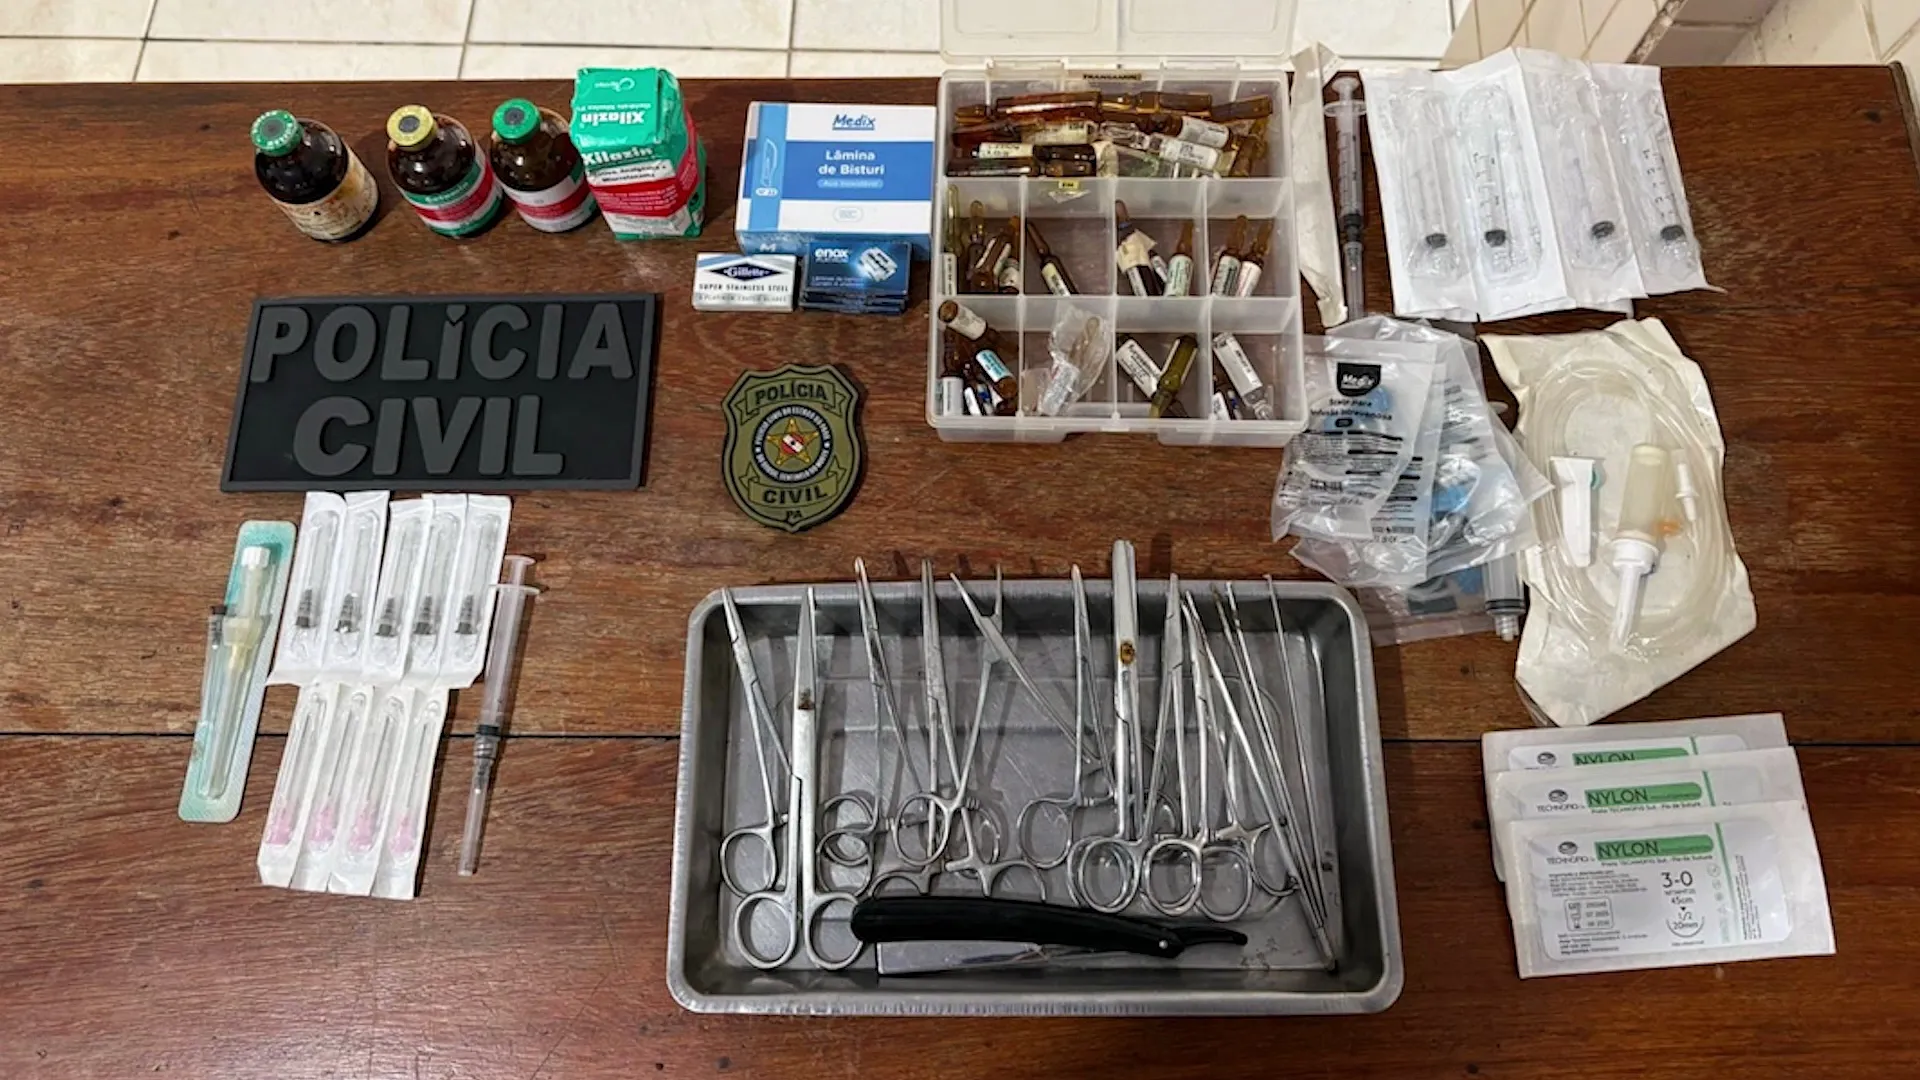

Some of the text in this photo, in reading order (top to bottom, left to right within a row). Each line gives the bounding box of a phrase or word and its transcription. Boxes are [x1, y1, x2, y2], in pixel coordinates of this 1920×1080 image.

[581, 110, 645, 126] Xilazin
[832, 114, 876, 130] Medix
[581, 146, 653, 167] Xilazin
[825, 149, 876, 161] Lâmina
[818, 163, 886, 176] de Bisturi
[815, 248, 849, 258] enox
[726, 266, 764, 278] Gillette
[699, 283, 788, 292] SUPER STAINLESS STEEL
[755, 380, 828, 404] POLÍCIA
[293, 395, 564, 476] CIVIL
[763, 485, 828, 504] CIVIL
[1586, 788, 1650, 806] NYLON
[1598, 840, 1660, 858] NYLON
[1661, 870, 1693, 888] 3-0
[1673, 920, 1698, 930] 20mm
